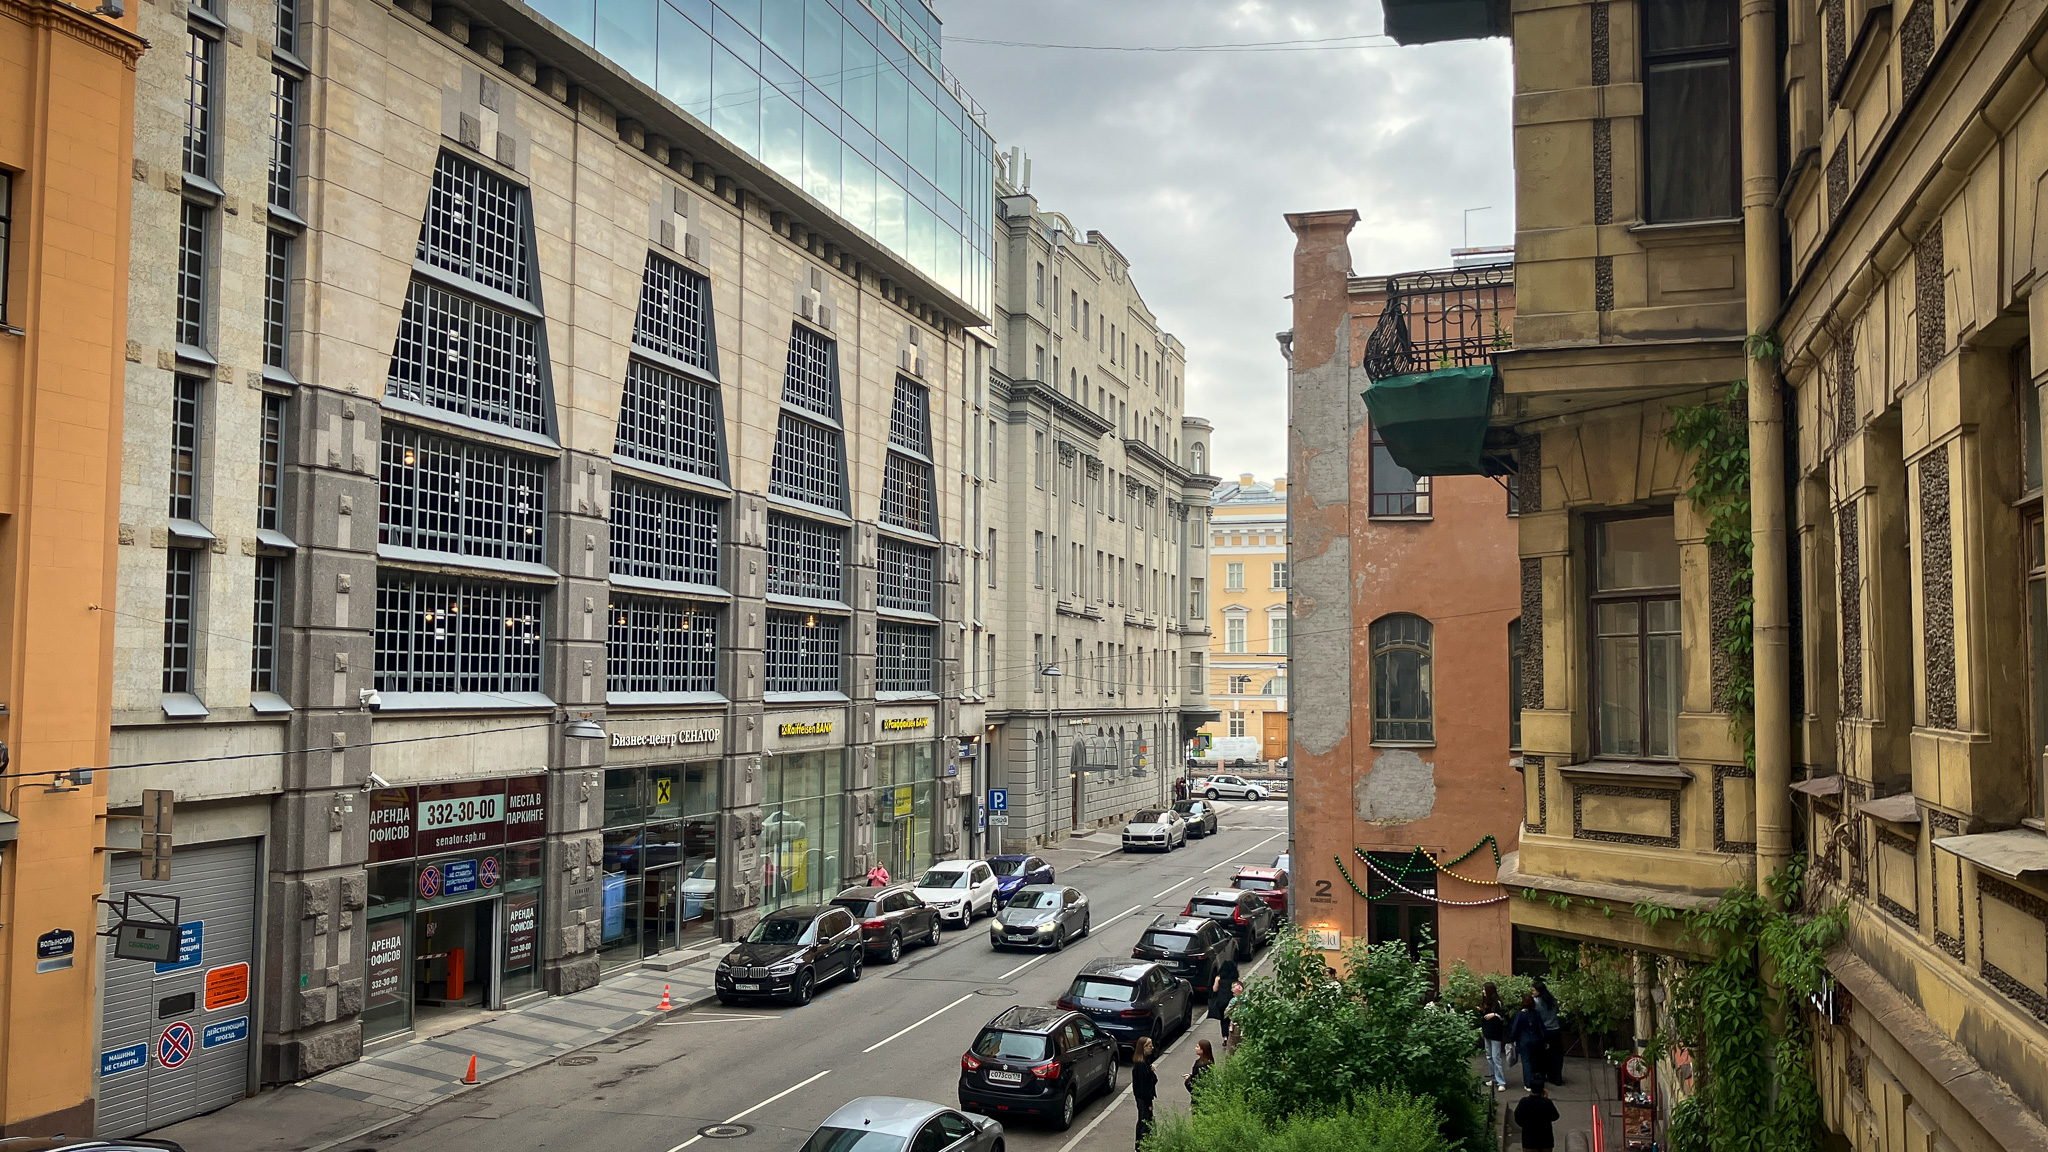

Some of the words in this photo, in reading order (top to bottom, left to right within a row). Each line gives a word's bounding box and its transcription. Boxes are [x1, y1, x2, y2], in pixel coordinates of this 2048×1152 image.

[816, 721, 832, 734] BANK
[612, 733, 677, 747] Бизнес-центр
[679, 728, 720, 743] СЕНАТОР
[510, 794, 535, 808] МЕСТА
[536, 793, 541, 805] В
[370, 807, 410, 825] АРЕНДА
[427, 798, 495, 826] 332-30-00
[506, 809, 544, 825] ПАРКИНГЕ
[369, 825, 410, 843] ОФИСОВ
[435, 831, 486, 847] senator.spb.ru
[1316, 880, 1332, 897] 2
[510, 907, 534, 921] АРЕНДА
[510, 919, 534, 934] ОФИСОВ
[40, 935, 73, 948] ВОЛЫНСКИЙ
[128, 940, 160, 950] СВОБОДНО
[371, 935, 401, 952] АРЕНДА
[510, 942, 532, 954] 332-30-00
[371, 950, 401, 967] ОФИСОВ
[371, 975, 398, 989] 332-30-00
[206, 1020, 245, 1037] ДЕЙСТВУЮЩИЙ
[108, 1050, 136, 1062] МАШИНЫ
[104, 1063, 113, 1072] НЕ
[113, 1057, 139, 1070] СТАВИТЬ!
